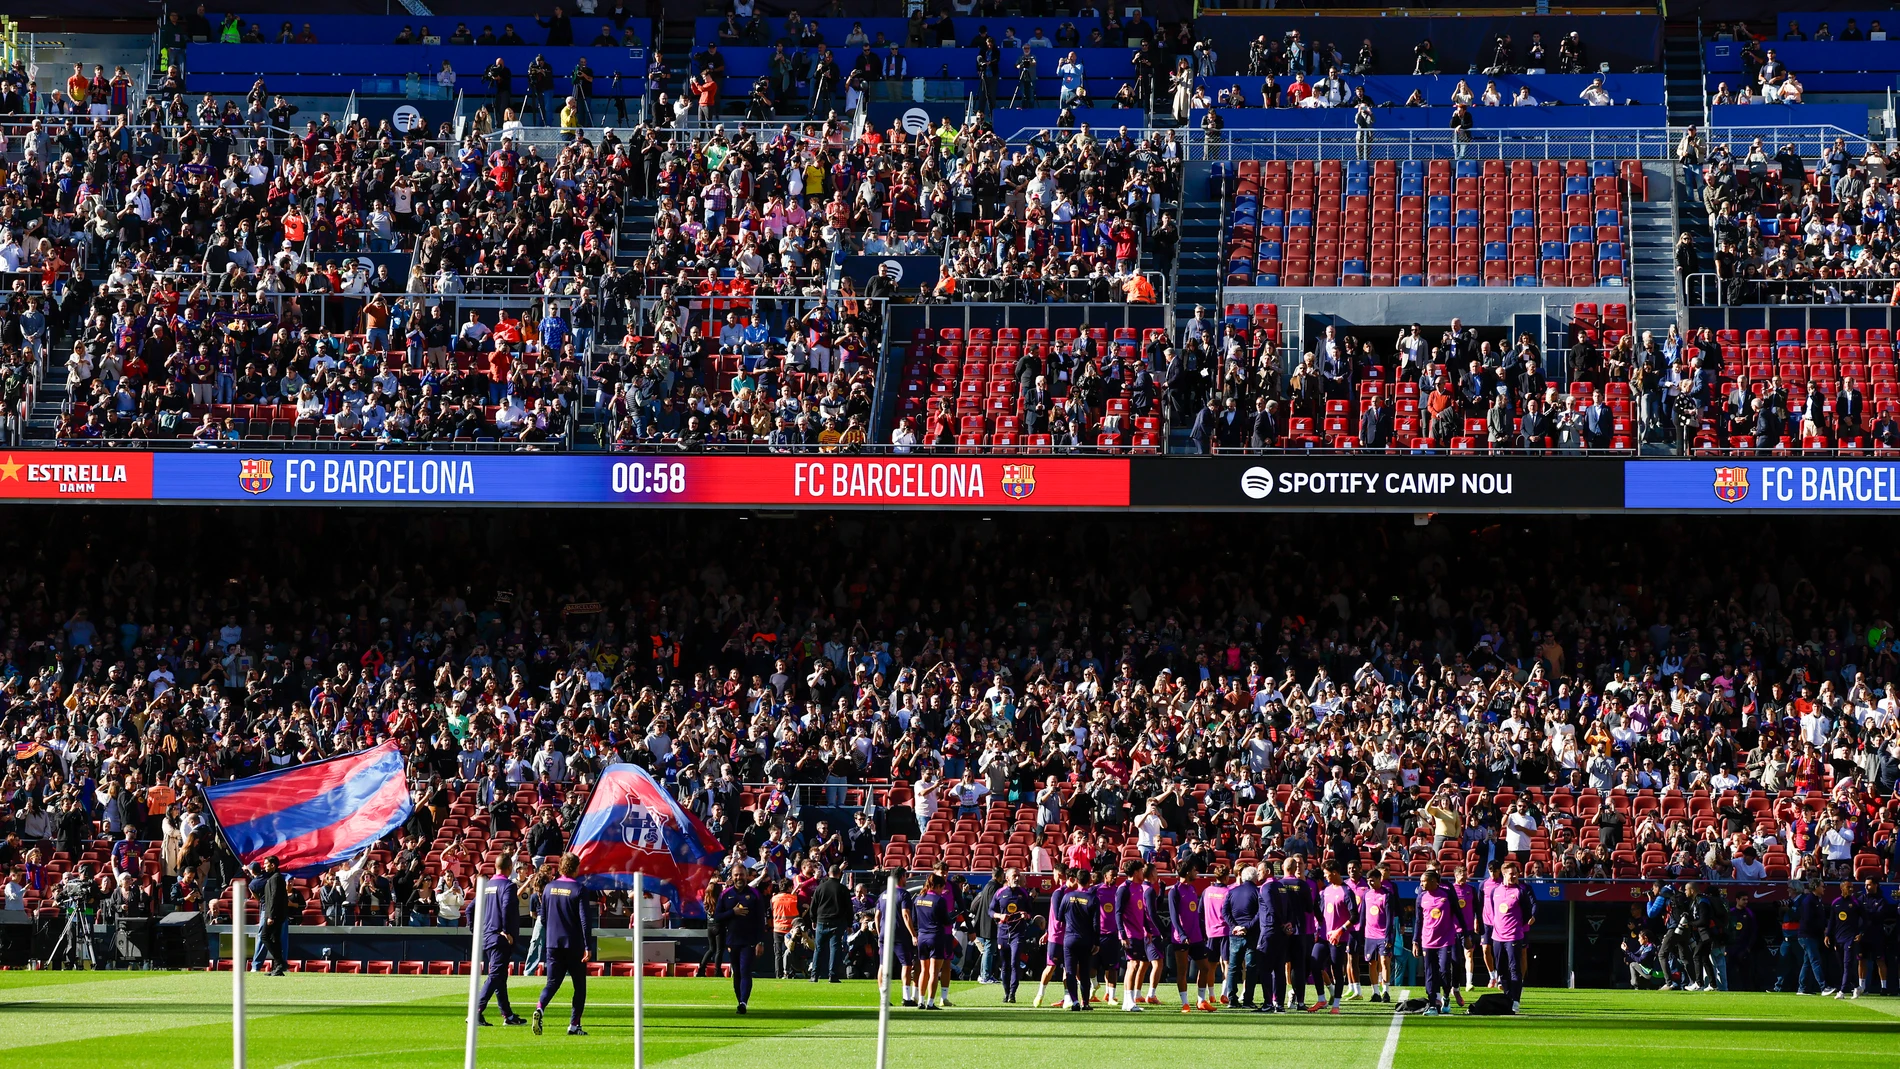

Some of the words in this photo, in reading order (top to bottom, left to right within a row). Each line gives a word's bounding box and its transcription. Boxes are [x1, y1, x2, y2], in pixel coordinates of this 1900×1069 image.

[27, 464, 127, 482] ESTRELLA
[59, 483, 95, 493] DAMM
[285, 459, 316, 493] FC
[323, 459, 474, 494] BARCELONA
[612, 462, 685, 493] 00:58
[794, 463, 825, 496] FC
[832, 463, 984, 498] BARCELONA
[1278, 472, 1380, 494] SPOTIFY
[1385, 472, 1455, 494] CAMP
[1462, 472, 1512, 494] NOU
[1762, 466, 1793, 501] FC
[1801, 467, 1900, 502] BARCEL
